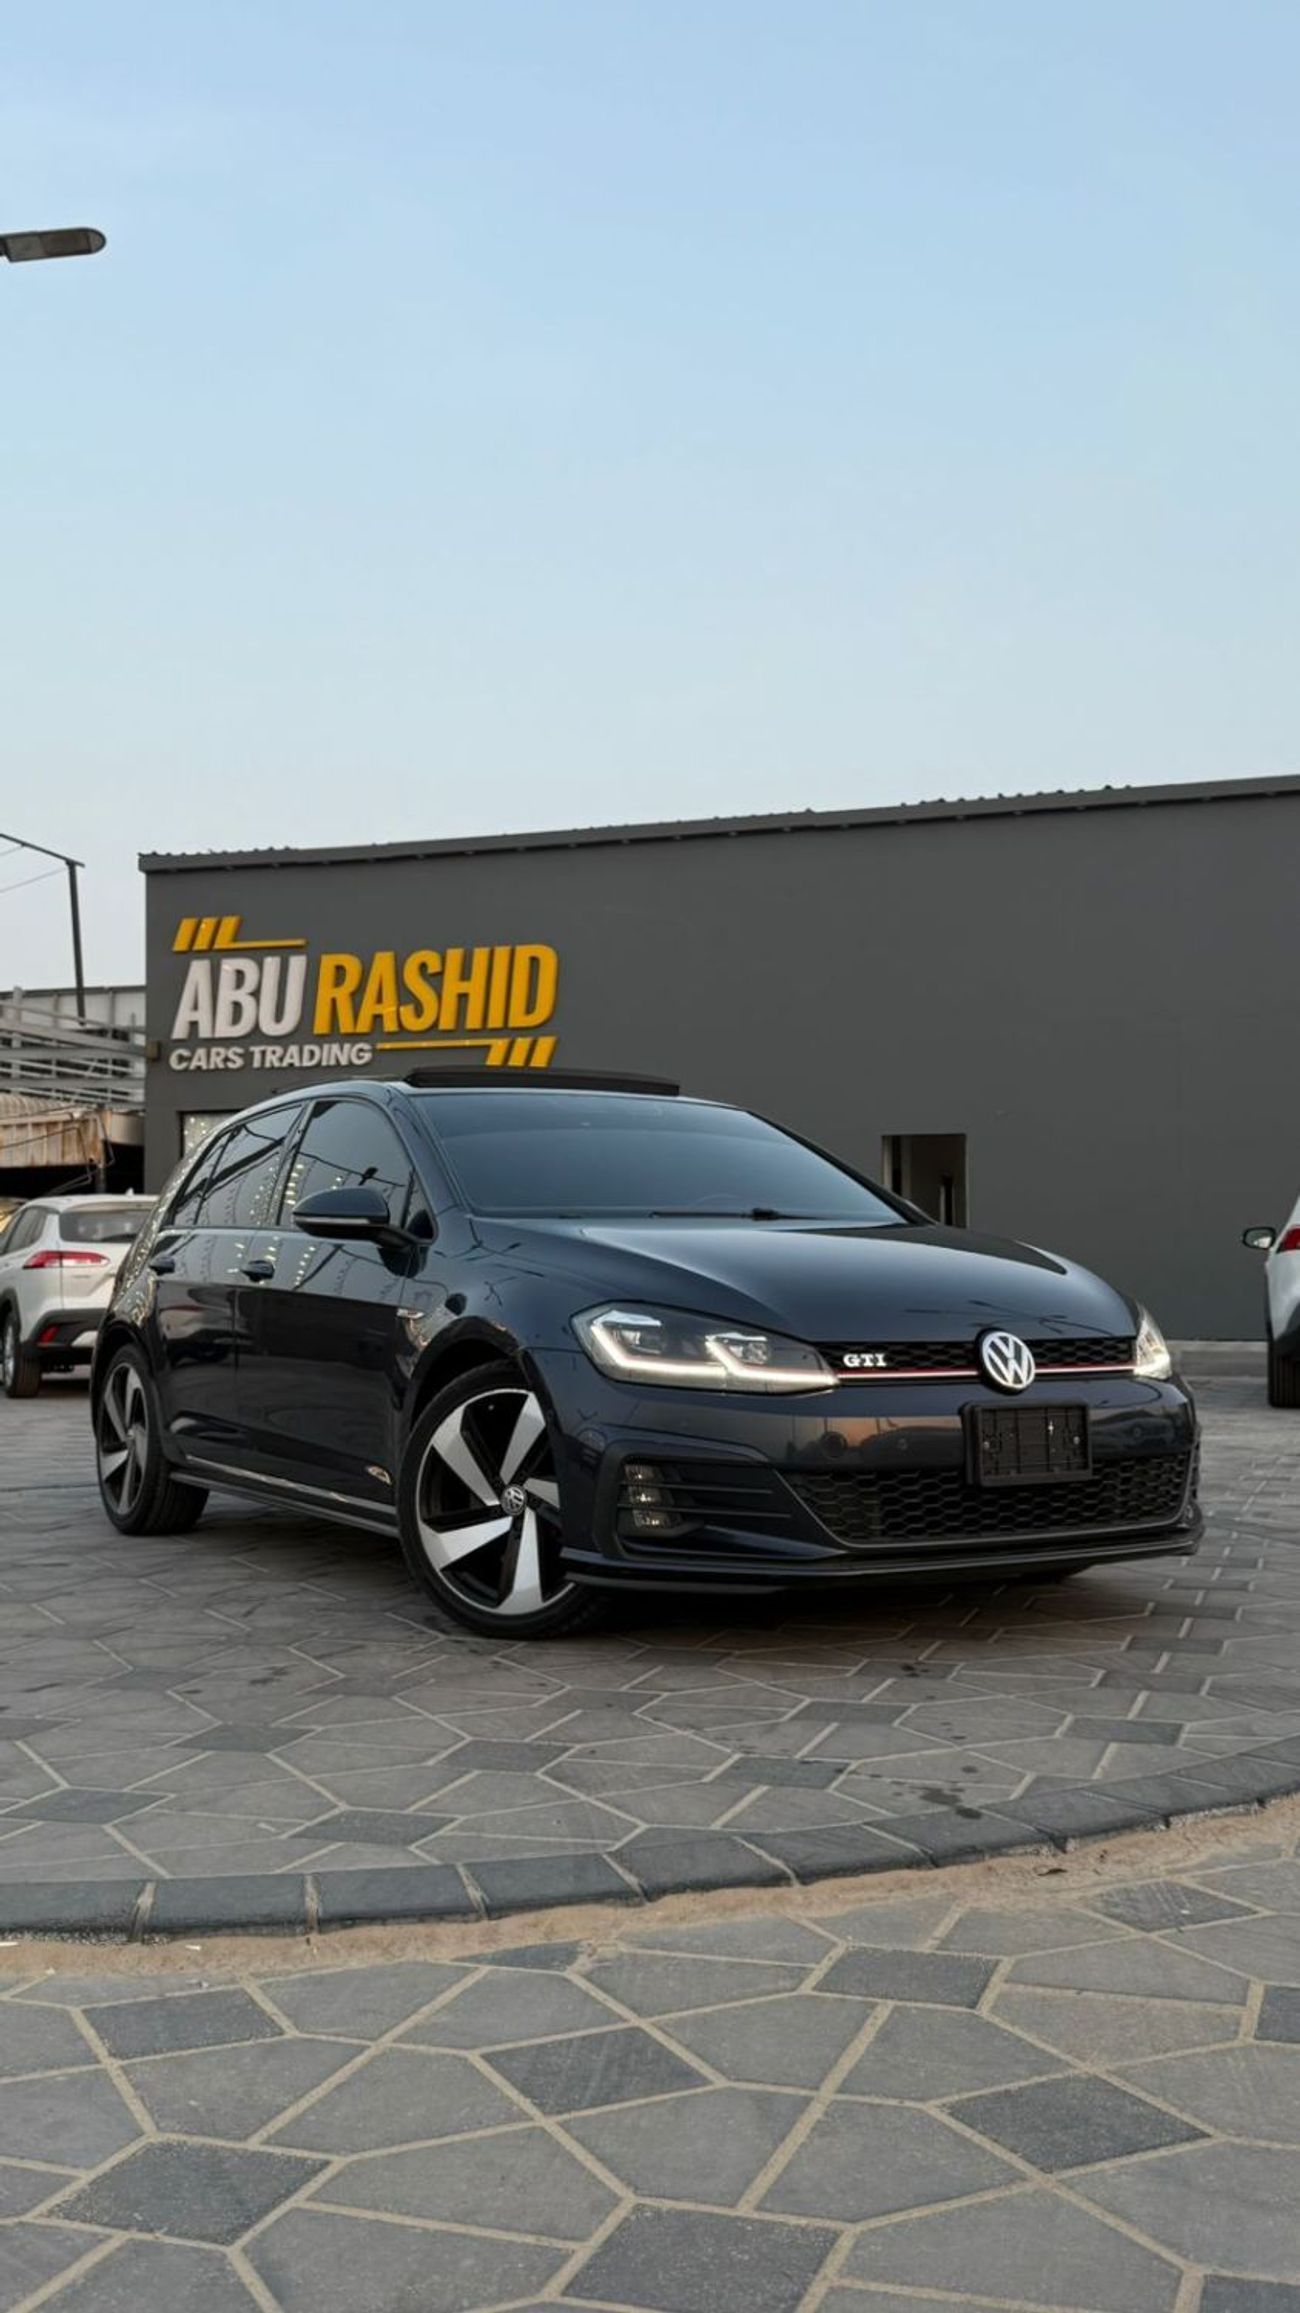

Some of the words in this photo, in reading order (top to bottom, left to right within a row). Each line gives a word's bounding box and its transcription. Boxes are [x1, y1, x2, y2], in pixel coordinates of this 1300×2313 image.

[170, 954, 307, 1039] ABU
[313, 944, 558, 1035] RASHID
[169, 1046, 245, 1071] CARS
[250, 1042, 373, 1068] TRADING
[843, 1352, 887, 1368] GTI
[981, 1330, 1036, 1390] VW
